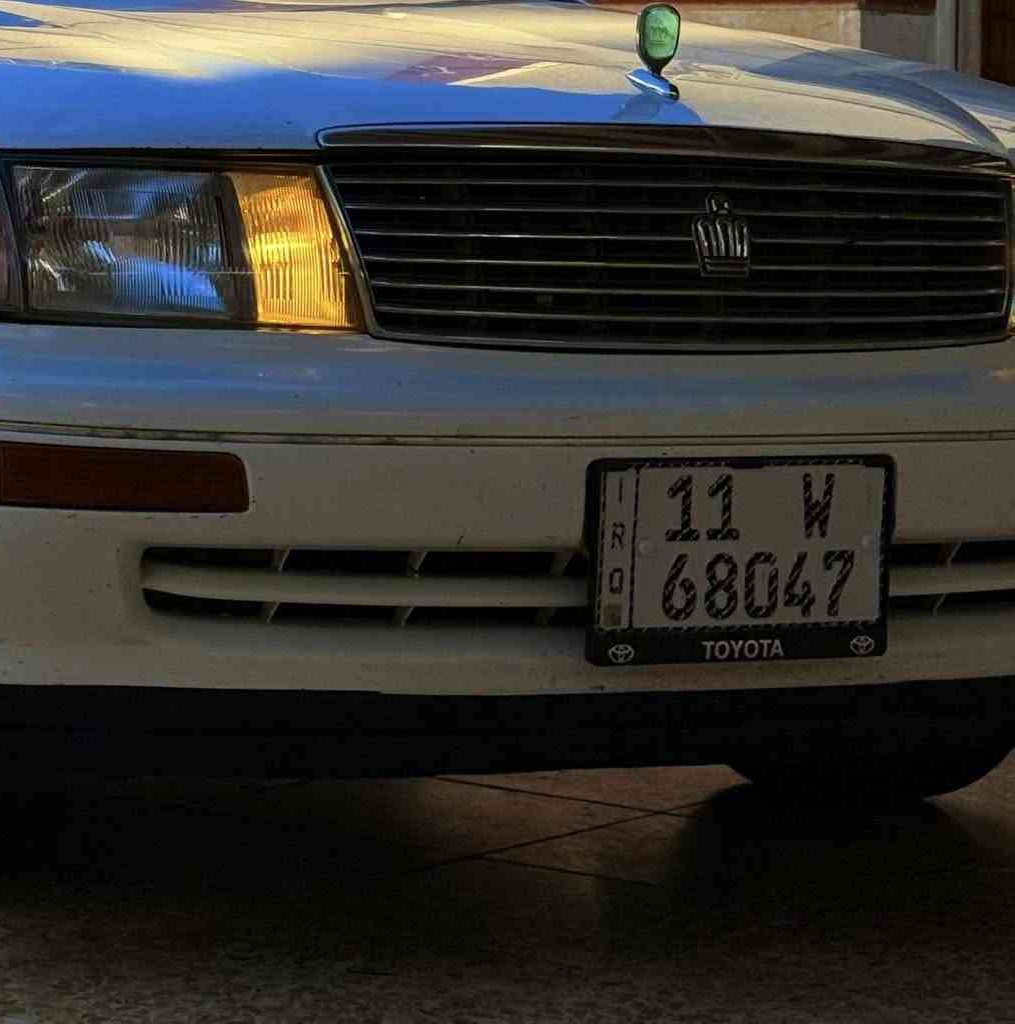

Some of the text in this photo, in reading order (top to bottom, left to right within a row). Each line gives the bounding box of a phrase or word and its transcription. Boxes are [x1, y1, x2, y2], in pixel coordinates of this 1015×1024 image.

[664, 471, 836, 543] 11 W
[660, 549, 855, 622] 68047
[701, 638, 786, 661] TOYOTA
